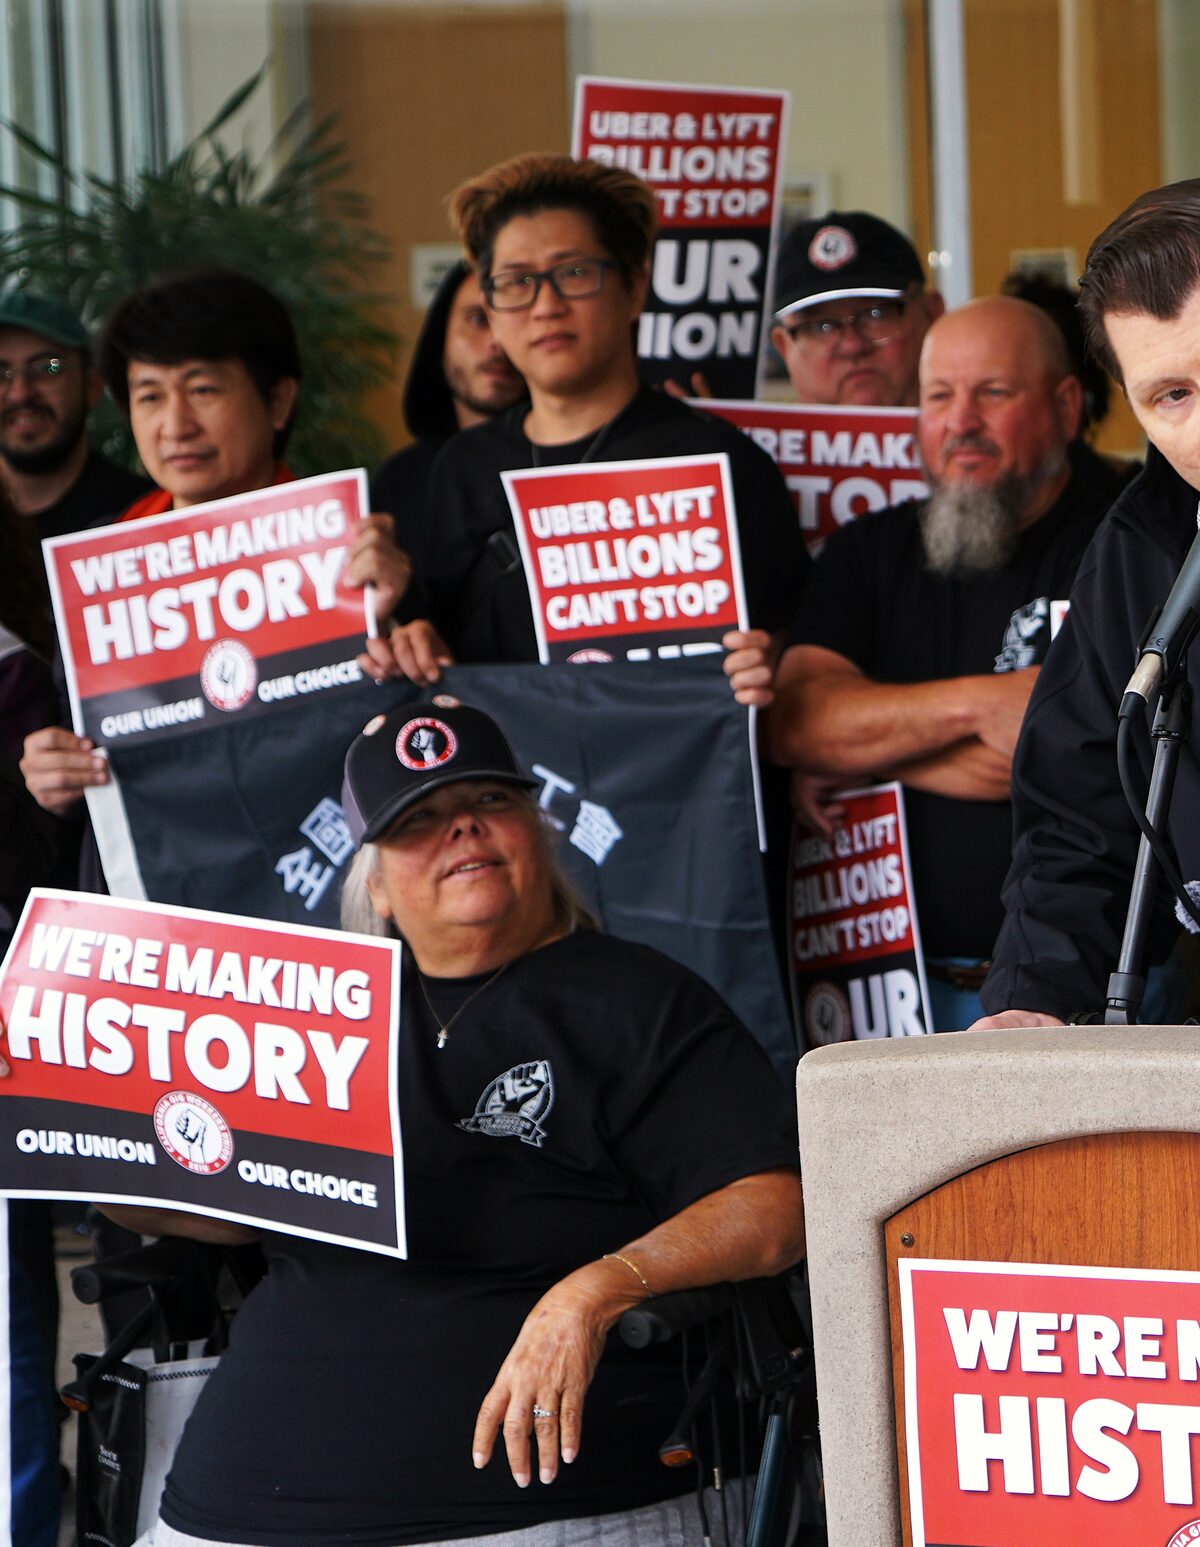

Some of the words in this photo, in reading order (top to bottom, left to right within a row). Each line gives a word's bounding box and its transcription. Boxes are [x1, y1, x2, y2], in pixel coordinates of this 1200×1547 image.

[589, 111, 669, 139] UBER
[674, 112, 695, 140] &
[702, 112, 774, 139] LYFT
[683, 188, 769, 218] STOP
[527, 499, 608, 539] UBER
[607, 497, 635, 531] &
[635, 485, 716, 527] LYFT
[70, 535, 194, 596] WE'RE
[194, 499, 345, 570] MAKING
[537, 526, 724, 588] BILLIONS
[82, 545, 346, 665] HISTORY
[546, 588, 639, 631] CAN'T
[639, 579, 730, 621] STOP
[257, 673, 299, 703] OUR
[296, 659, 362, 694] CHOICE
[101, 708, 145, 737] OUR
[143, 697, 204, 729] UNION
[853, 812, 897, 855] LYFT
[794, 855, 902, 917] BILLIONS
[797, 920, 855, 959] CAN'T
[856, 905, 909, 948] STOP
[28, 923, 163, 989] WE'RE
[164, 943, 372, 1021] MAKING
[7, 985, 370, 1111] HISTORY
[16, 1128, 76, 1156] OUR
[77, 1132, 157, 1165] UNION
[238, 1159, 291, 1190] OUR
[290, 1168, 378, 1208] CHOICE
[942, 1306, 1168, 1379] WE'RE
